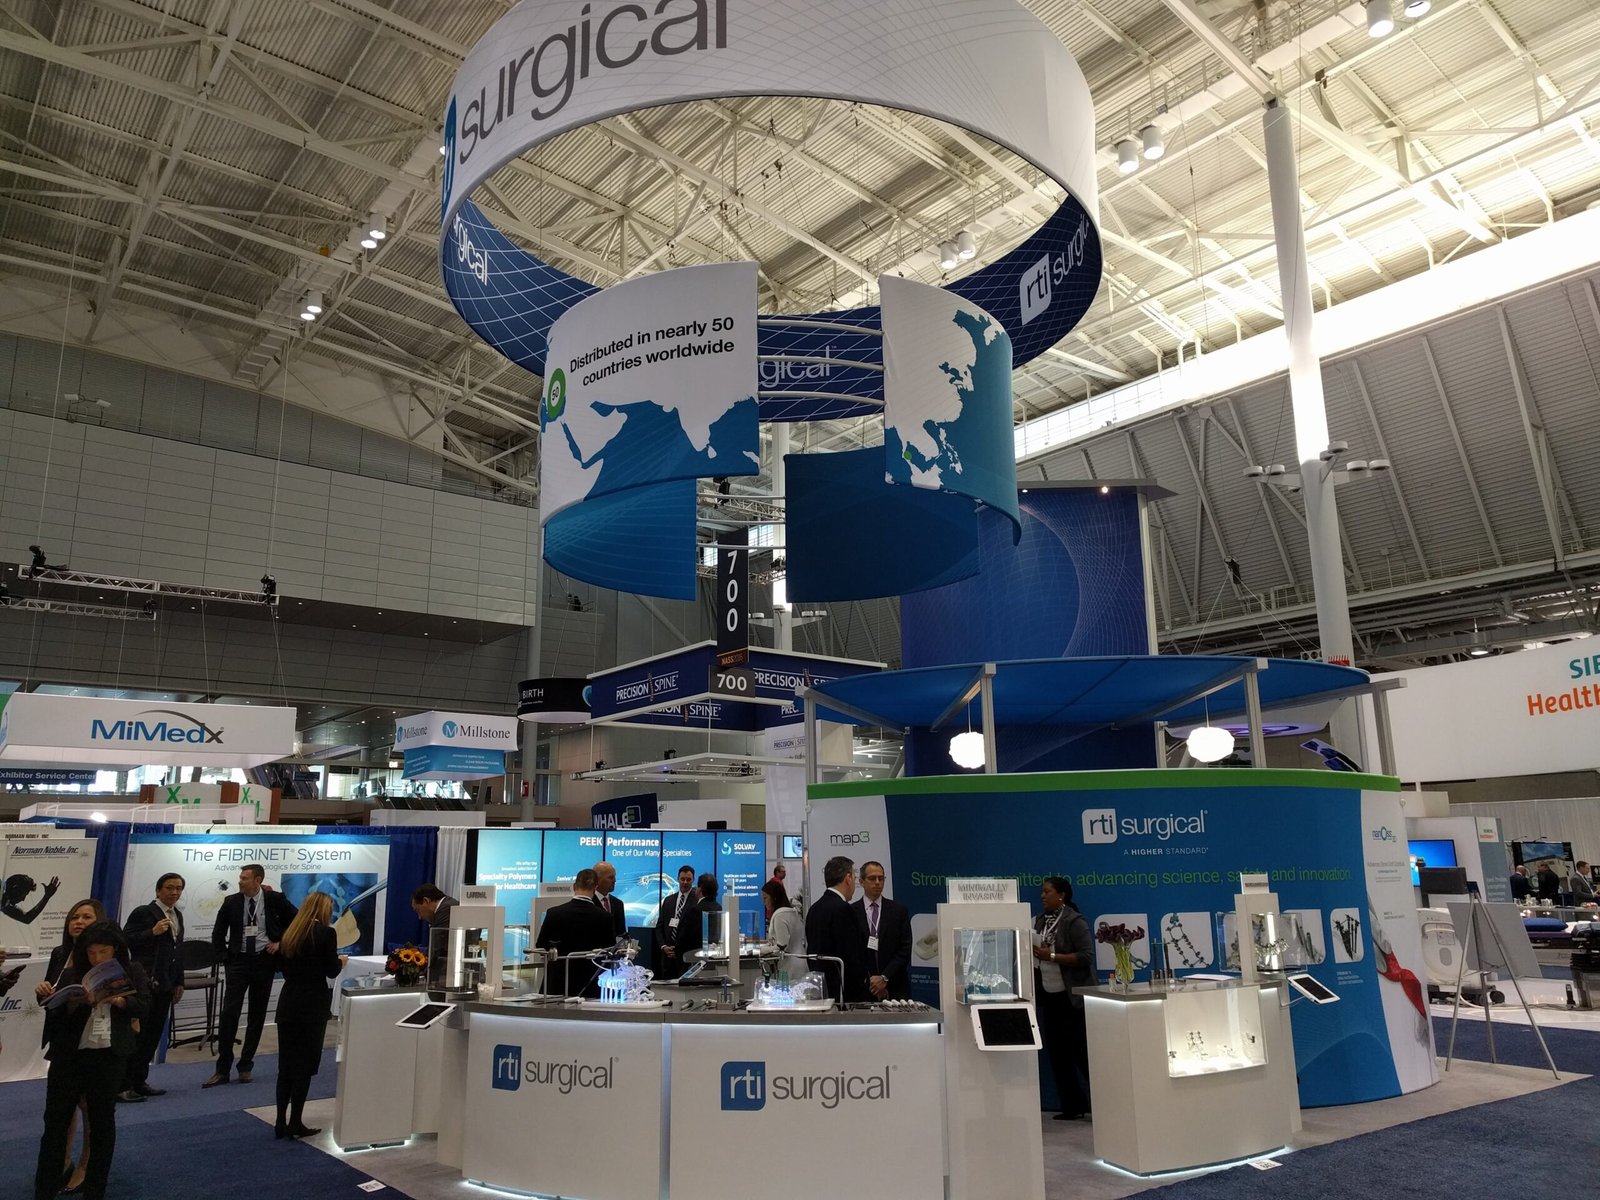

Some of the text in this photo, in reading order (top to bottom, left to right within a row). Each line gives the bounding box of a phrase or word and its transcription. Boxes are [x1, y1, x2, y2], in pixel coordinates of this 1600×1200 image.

[460, 0, 728, 165] surgical
[1026, 265, 1048, 309] rti
[570, 316, 735, 373] Distributed in nearly 50
[582, 339, 735, 386] countries worldwide
[551, 386, 560, 401] 50
[726, 550, 739, 632] 700
[616, 674, 678, 701] PRECISION SPINE
[716, 673, 748, 691] 700
[754, 672, 805, 688] PRECISION
[522, 688, 544, 699] BIRTH
[689, 704, 721, 717] SPINE
[460, 725, 511, 739] Millstone
[35, 772, 67, 780] Service
[1089, 809, 1206, 841] rti surgical
[579, 837, 660, 847] PEEK Performance
[830, 831, 870, 846] map3
[12, 846, 43, 854] Norman
[183, 848, 352, 863] The FIBRINET System
[612, 849, 692, 858] One of Our Many Specialties
[1131, 848, 1163, 856] HIGHER
[1165, 847, 1207, 855] STANDARD
[301, 864, 322, 872] Spine
[479, 873, 537, 881] Specialty Polymers
[1076, 870, 1158, 889] advancing
[1271, 867, 1296, 881] and
[1299, 867, 1352, 881] innovation
[1, 997, 22, 1011] Inc.
[498, 1055, 614, 1094] rti surgical
[729, 1065, 891, 1109] rti surgical
